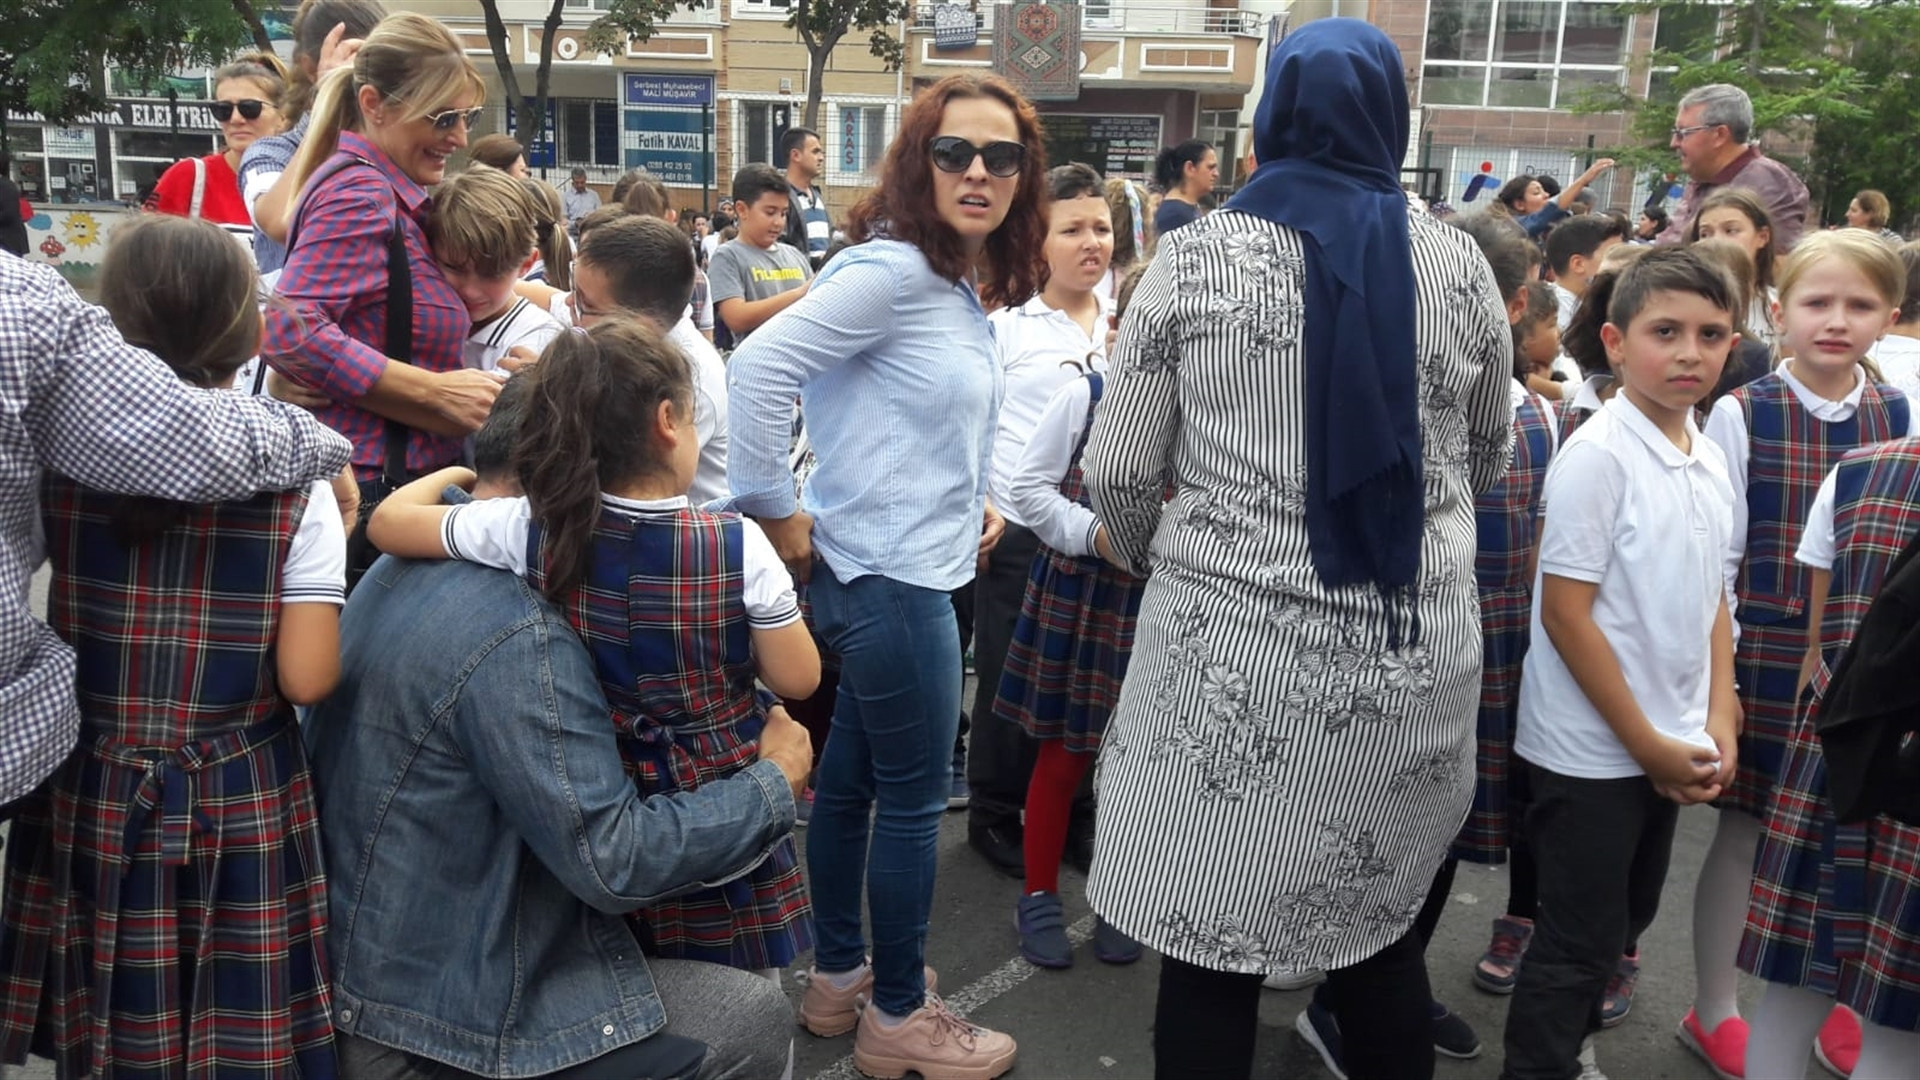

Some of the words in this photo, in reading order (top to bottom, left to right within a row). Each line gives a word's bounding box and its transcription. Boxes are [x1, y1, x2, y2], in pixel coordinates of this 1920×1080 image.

[634, 81, 661, 89] Serbest
[662, 82, 706, 91] Muhasebeci
[638, 134, 664, 149] Fatih
[667, 136, 700, 150] KAVAL
[844, 110, 855, 165] ARAS
